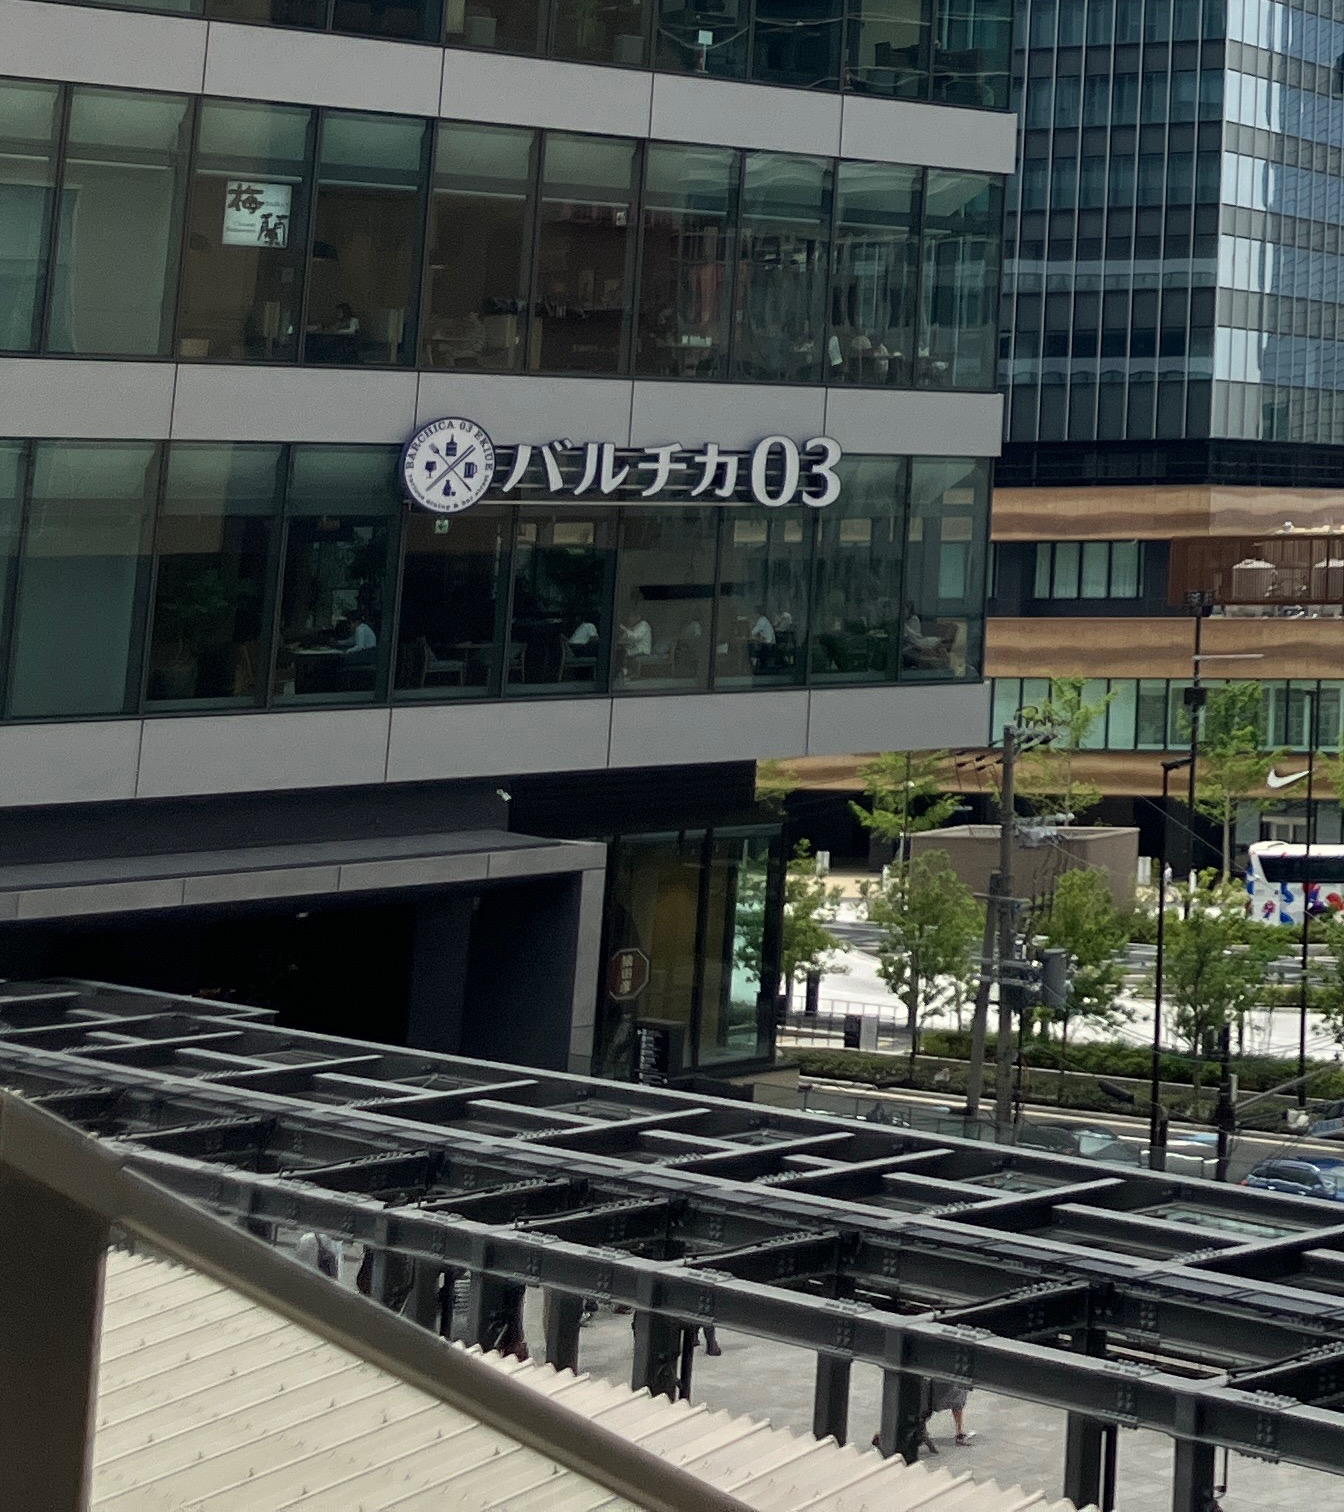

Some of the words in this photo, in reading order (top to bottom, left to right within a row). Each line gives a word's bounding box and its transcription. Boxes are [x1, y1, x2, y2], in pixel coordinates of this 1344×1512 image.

[405, 420, 455, 470] BARCHICA
[460, 421, 473, 433] 03
[474, 428, 493, 471] EKIUE
[502, 436, 843, 507] バルチカ03
